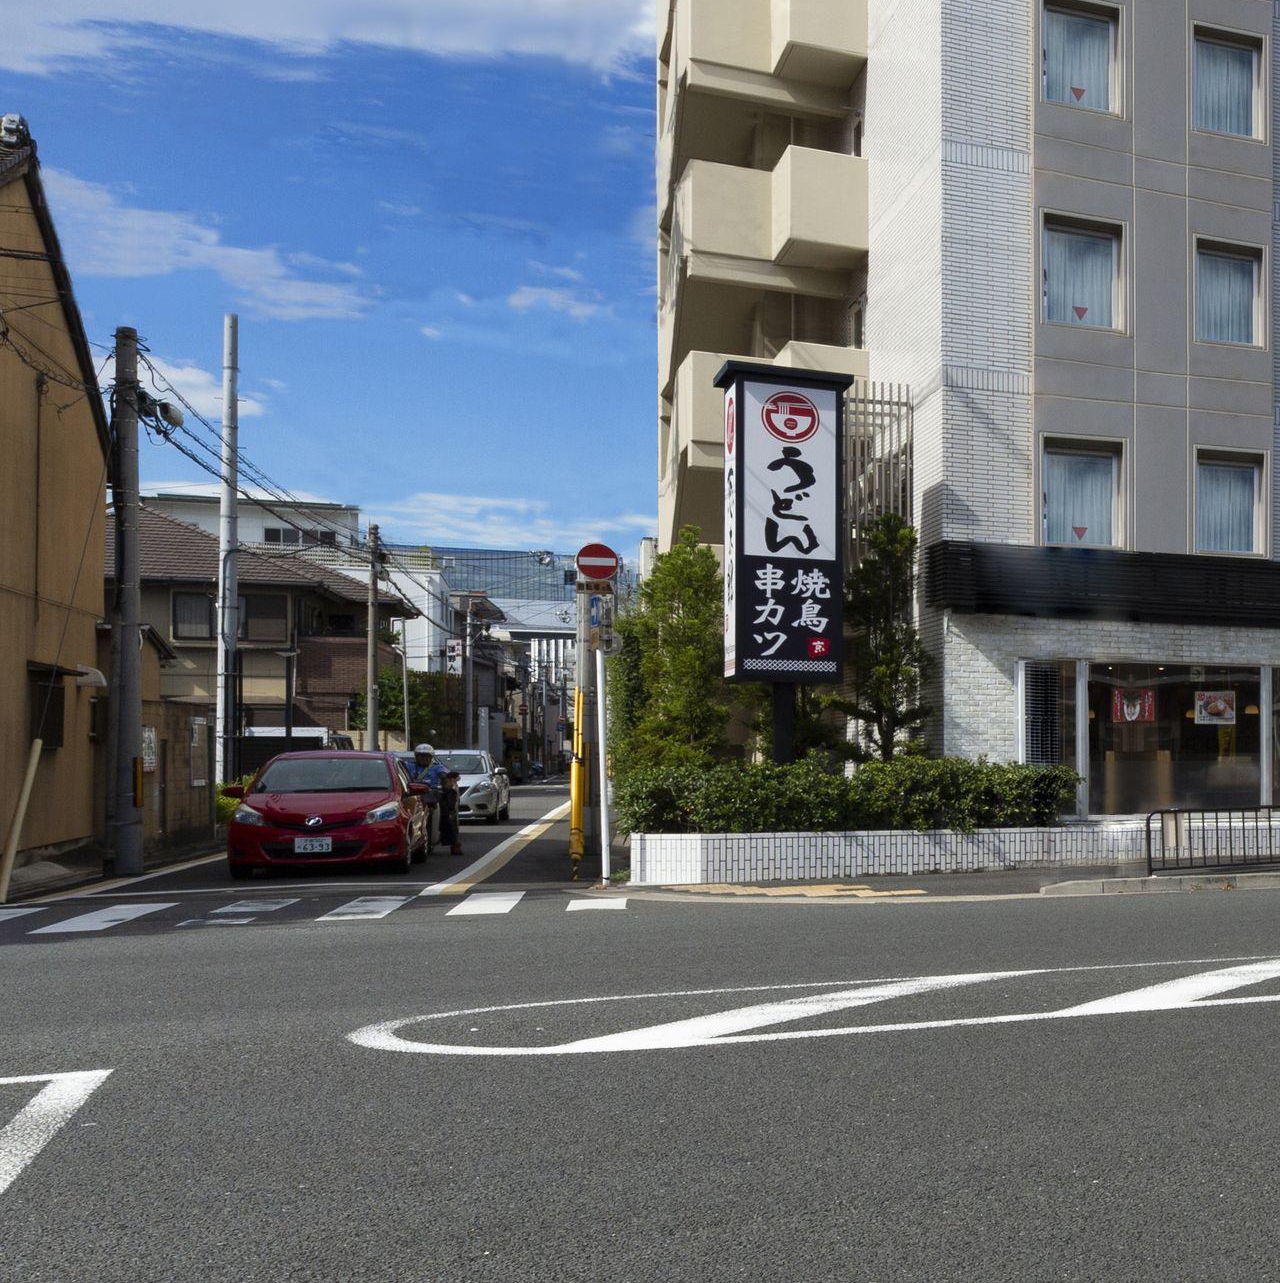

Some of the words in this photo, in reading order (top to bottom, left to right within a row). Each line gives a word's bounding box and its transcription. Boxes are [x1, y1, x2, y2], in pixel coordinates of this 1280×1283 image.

[764, 446, 820, 555] うどん
[753, 563, 788, 656] 串カツ
[791, 568, 832, 633] 焼鳥
[303, 843, 330, 852] 63-93
